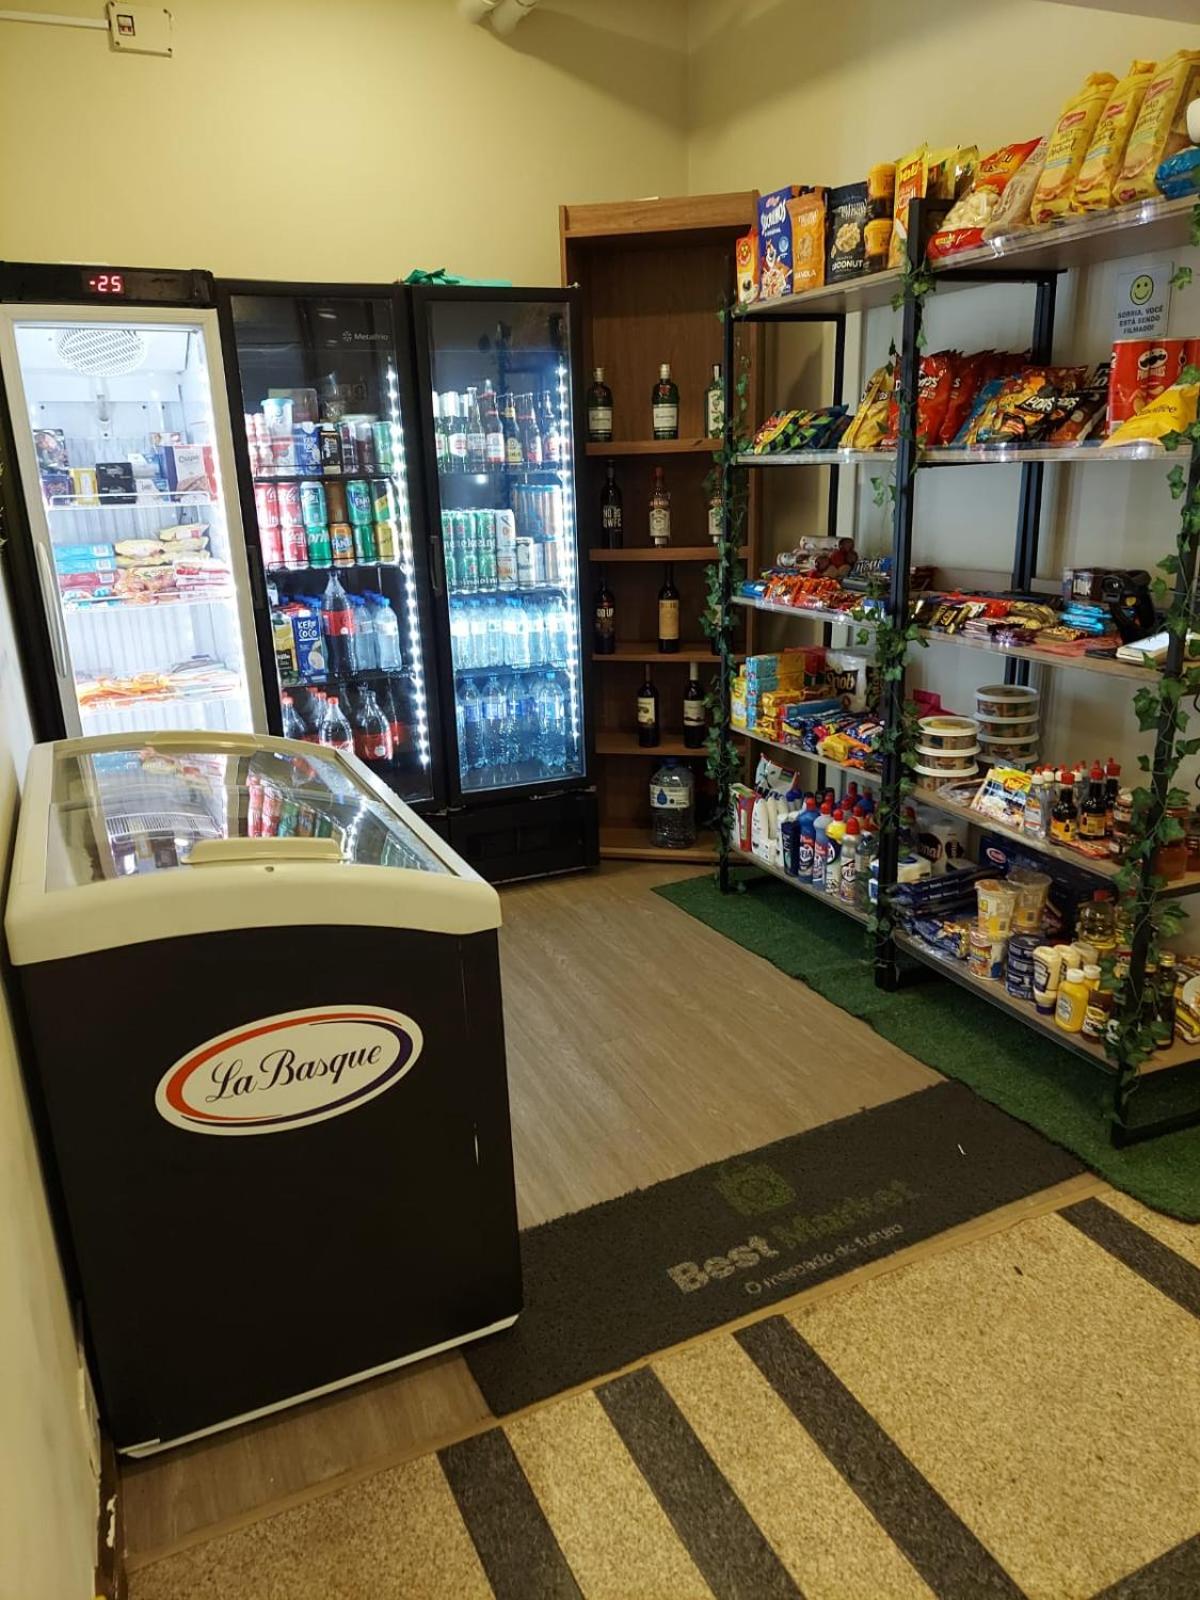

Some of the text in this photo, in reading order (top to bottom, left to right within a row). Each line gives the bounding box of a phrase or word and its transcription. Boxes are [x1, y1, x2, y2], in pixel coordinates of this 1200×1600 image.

[89, 276, 122, 292] -25
[299, 629, 318, 638] COCO
[205, 1045, 382, 1103] La Basque
[666, 1235, 780, 1294] Best
[744, 1280, 762, 1295] O
